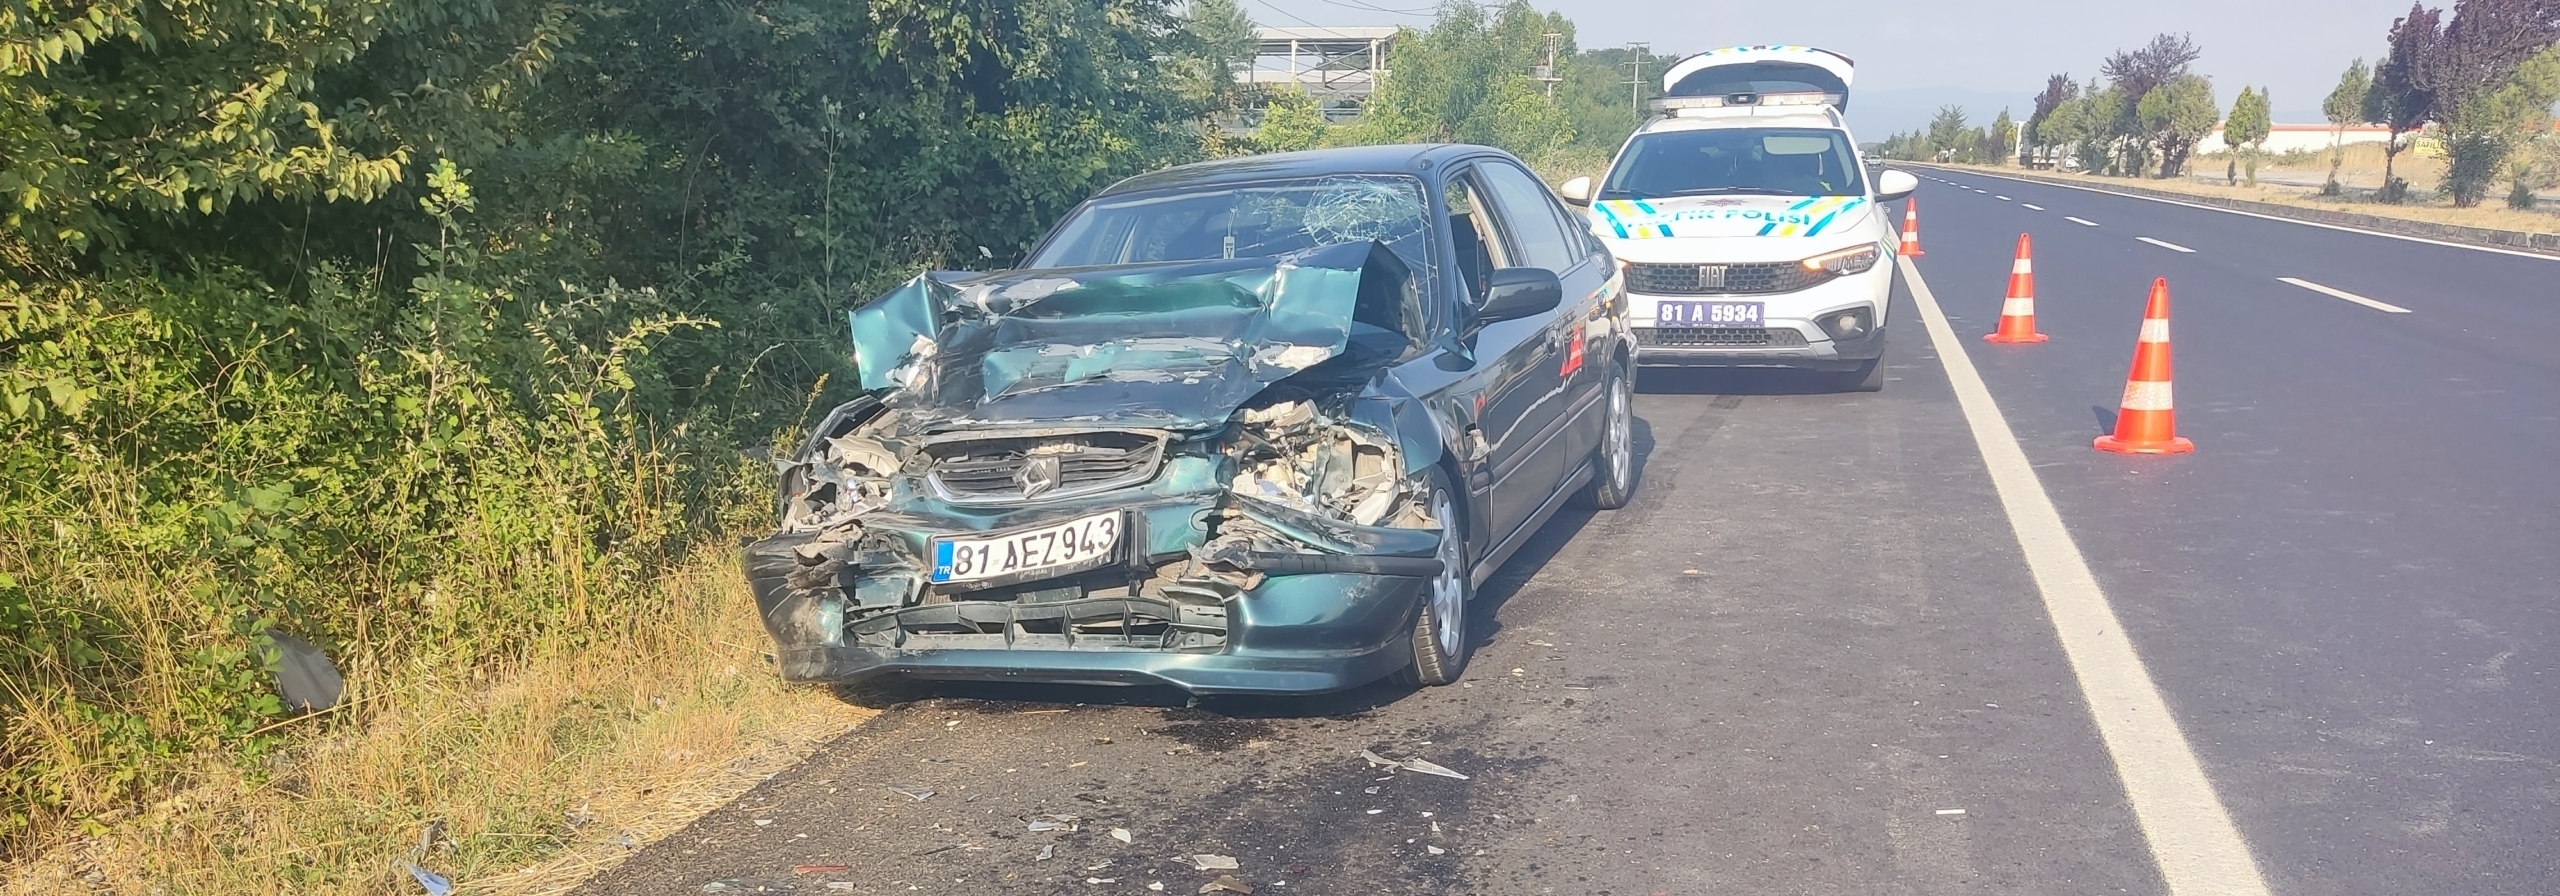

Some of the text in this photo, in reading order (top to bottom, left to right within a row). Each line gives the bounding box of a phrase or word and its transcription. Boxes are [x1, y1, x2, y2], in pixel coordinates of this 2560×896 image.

[1698, 265, 1728, 288] FIAT
[1661, 304, 1758, 322] 81 A 5934
[938, 565, 951, 575] TR
[954, 545, 990, 576] 81
